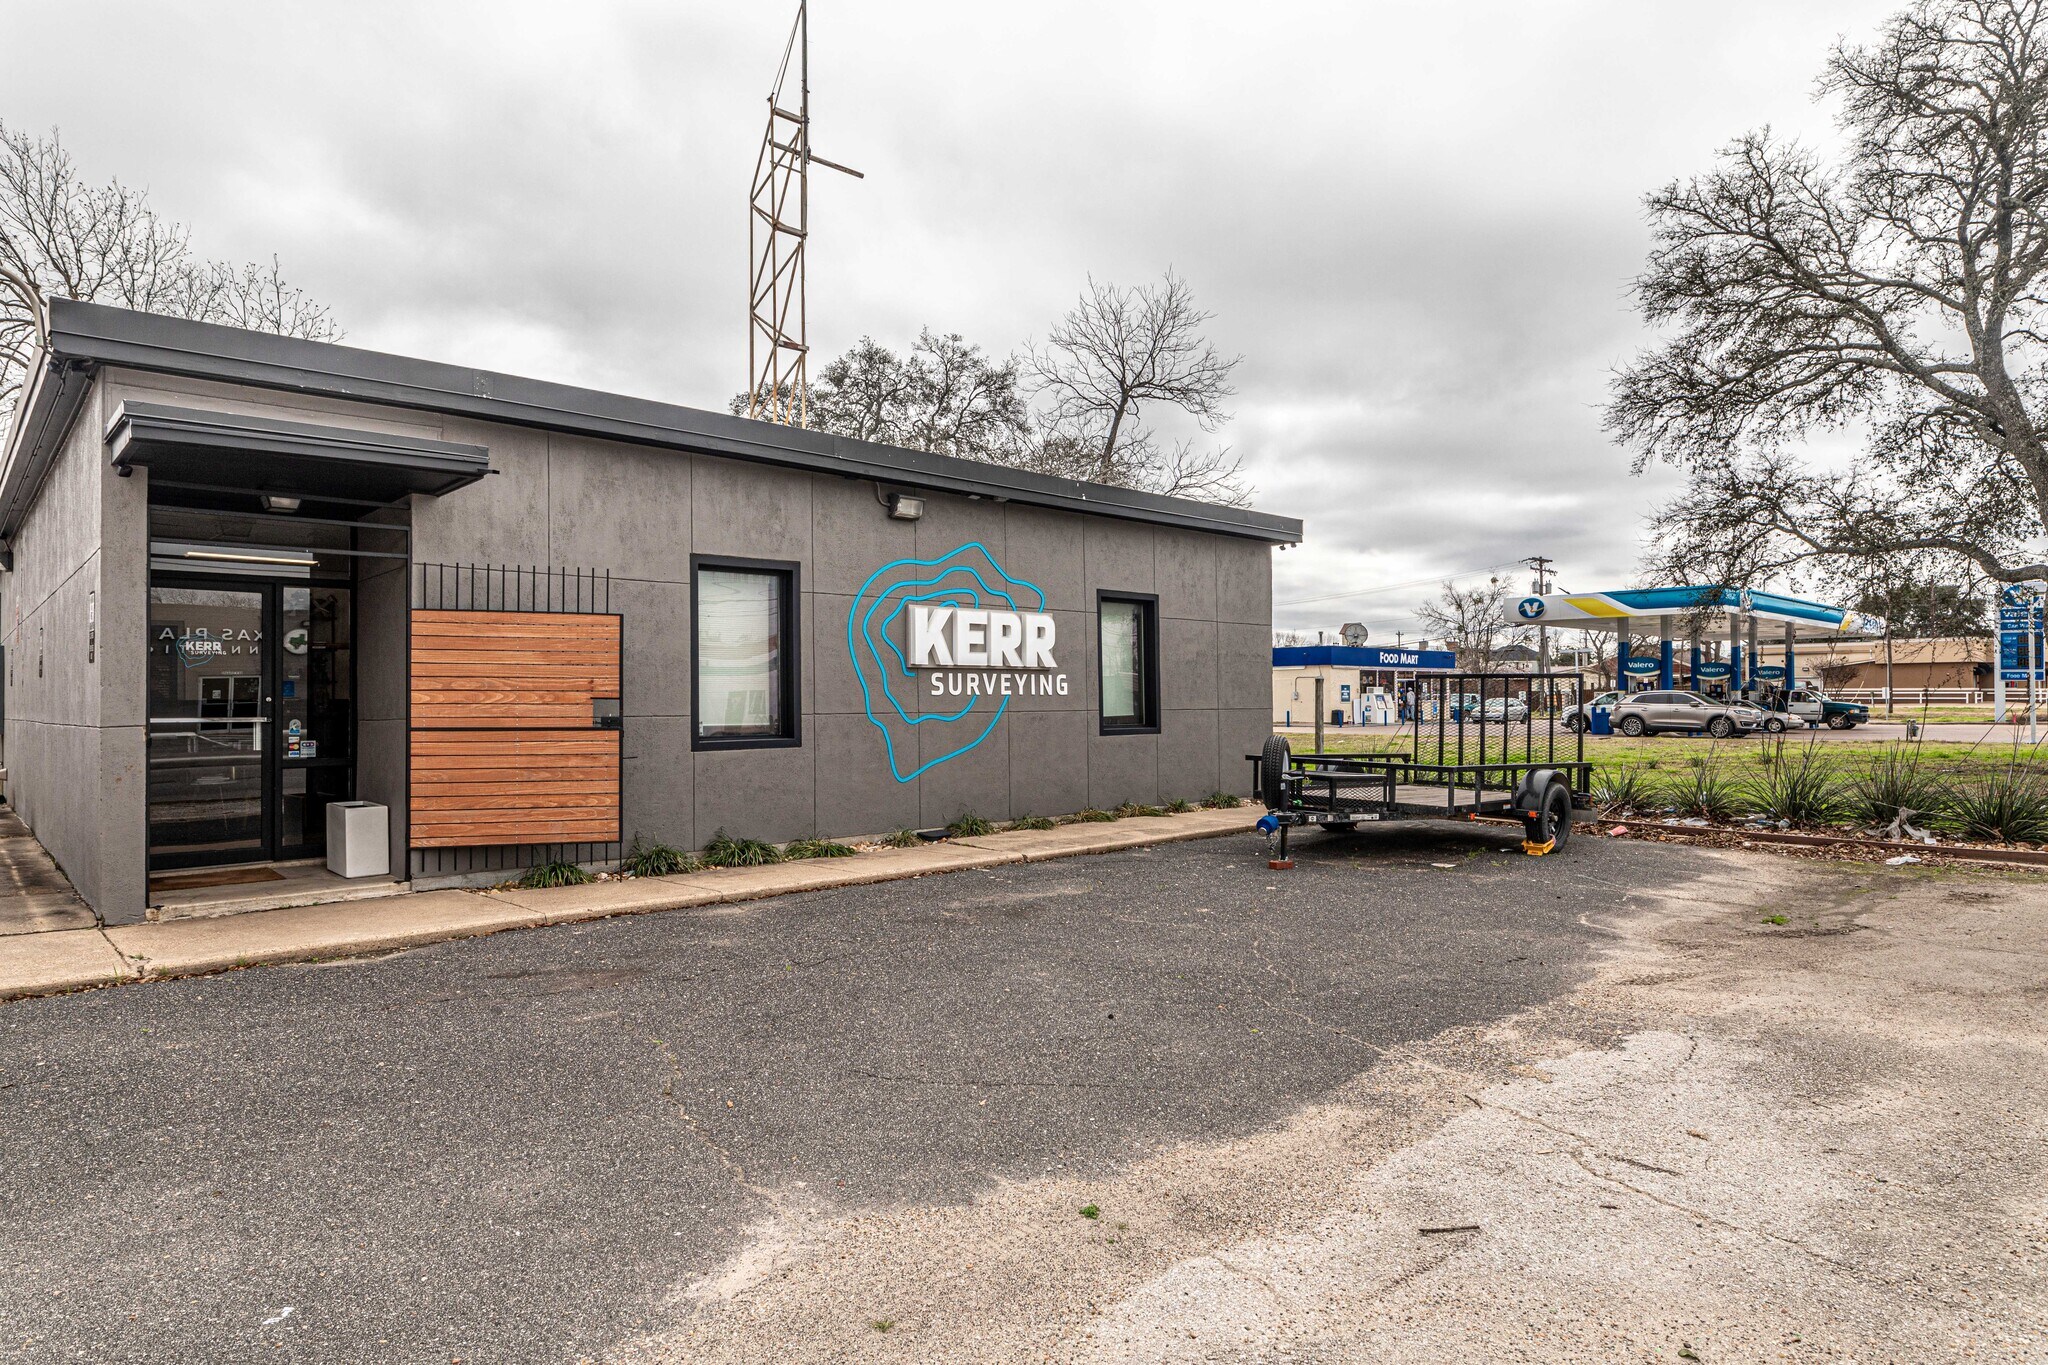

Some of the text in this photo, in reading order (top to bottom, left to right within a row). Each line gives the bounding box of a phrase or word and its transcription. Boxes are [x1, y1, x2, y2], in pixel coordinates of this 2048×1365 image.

[185, 641, 222, 651] KERR
[911, 606, 1058, 668] KERR
[1380, 651, 1419, 665] FOOD MART
[931, 672, 1068, 696] SURVEYING
